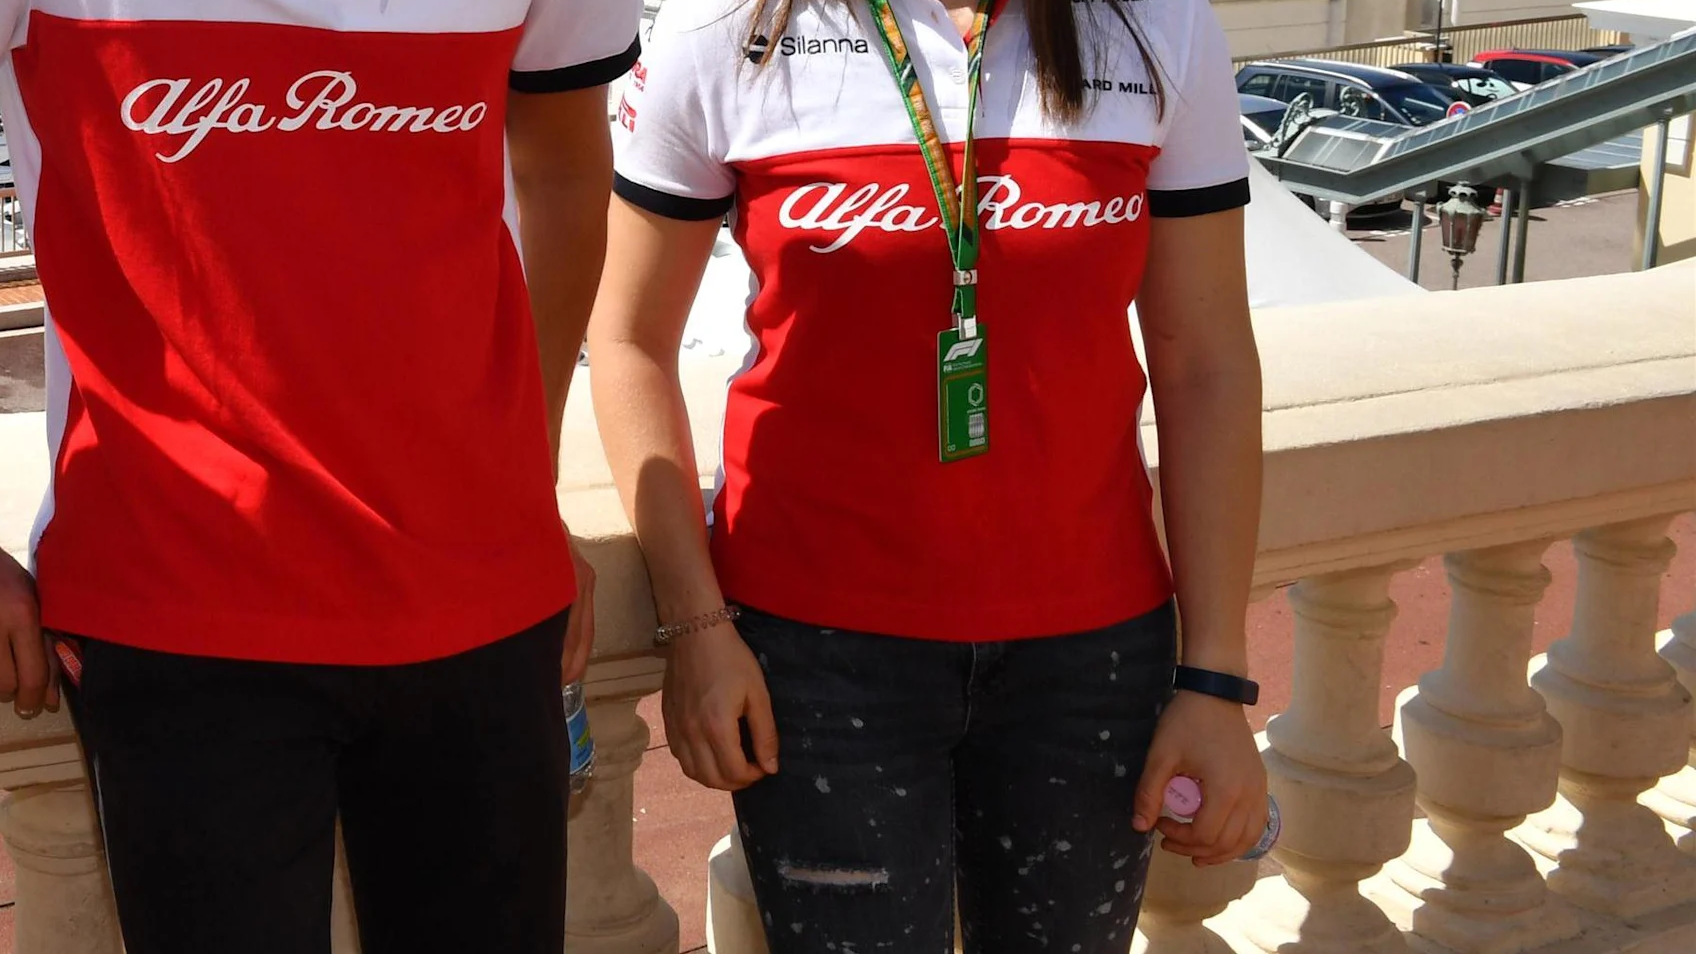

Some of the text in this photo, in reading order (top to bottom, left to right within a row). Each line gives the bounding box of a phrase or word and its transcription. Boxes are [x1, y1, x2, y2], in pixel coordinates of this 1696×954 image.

[780, 35, 869, 56] Silanna
[1119, 82, 1157, 95] MILL
[120, 70, 487, 163] Alfa Romeo
[778, 175, 1144, 254] Alfa Romeo
